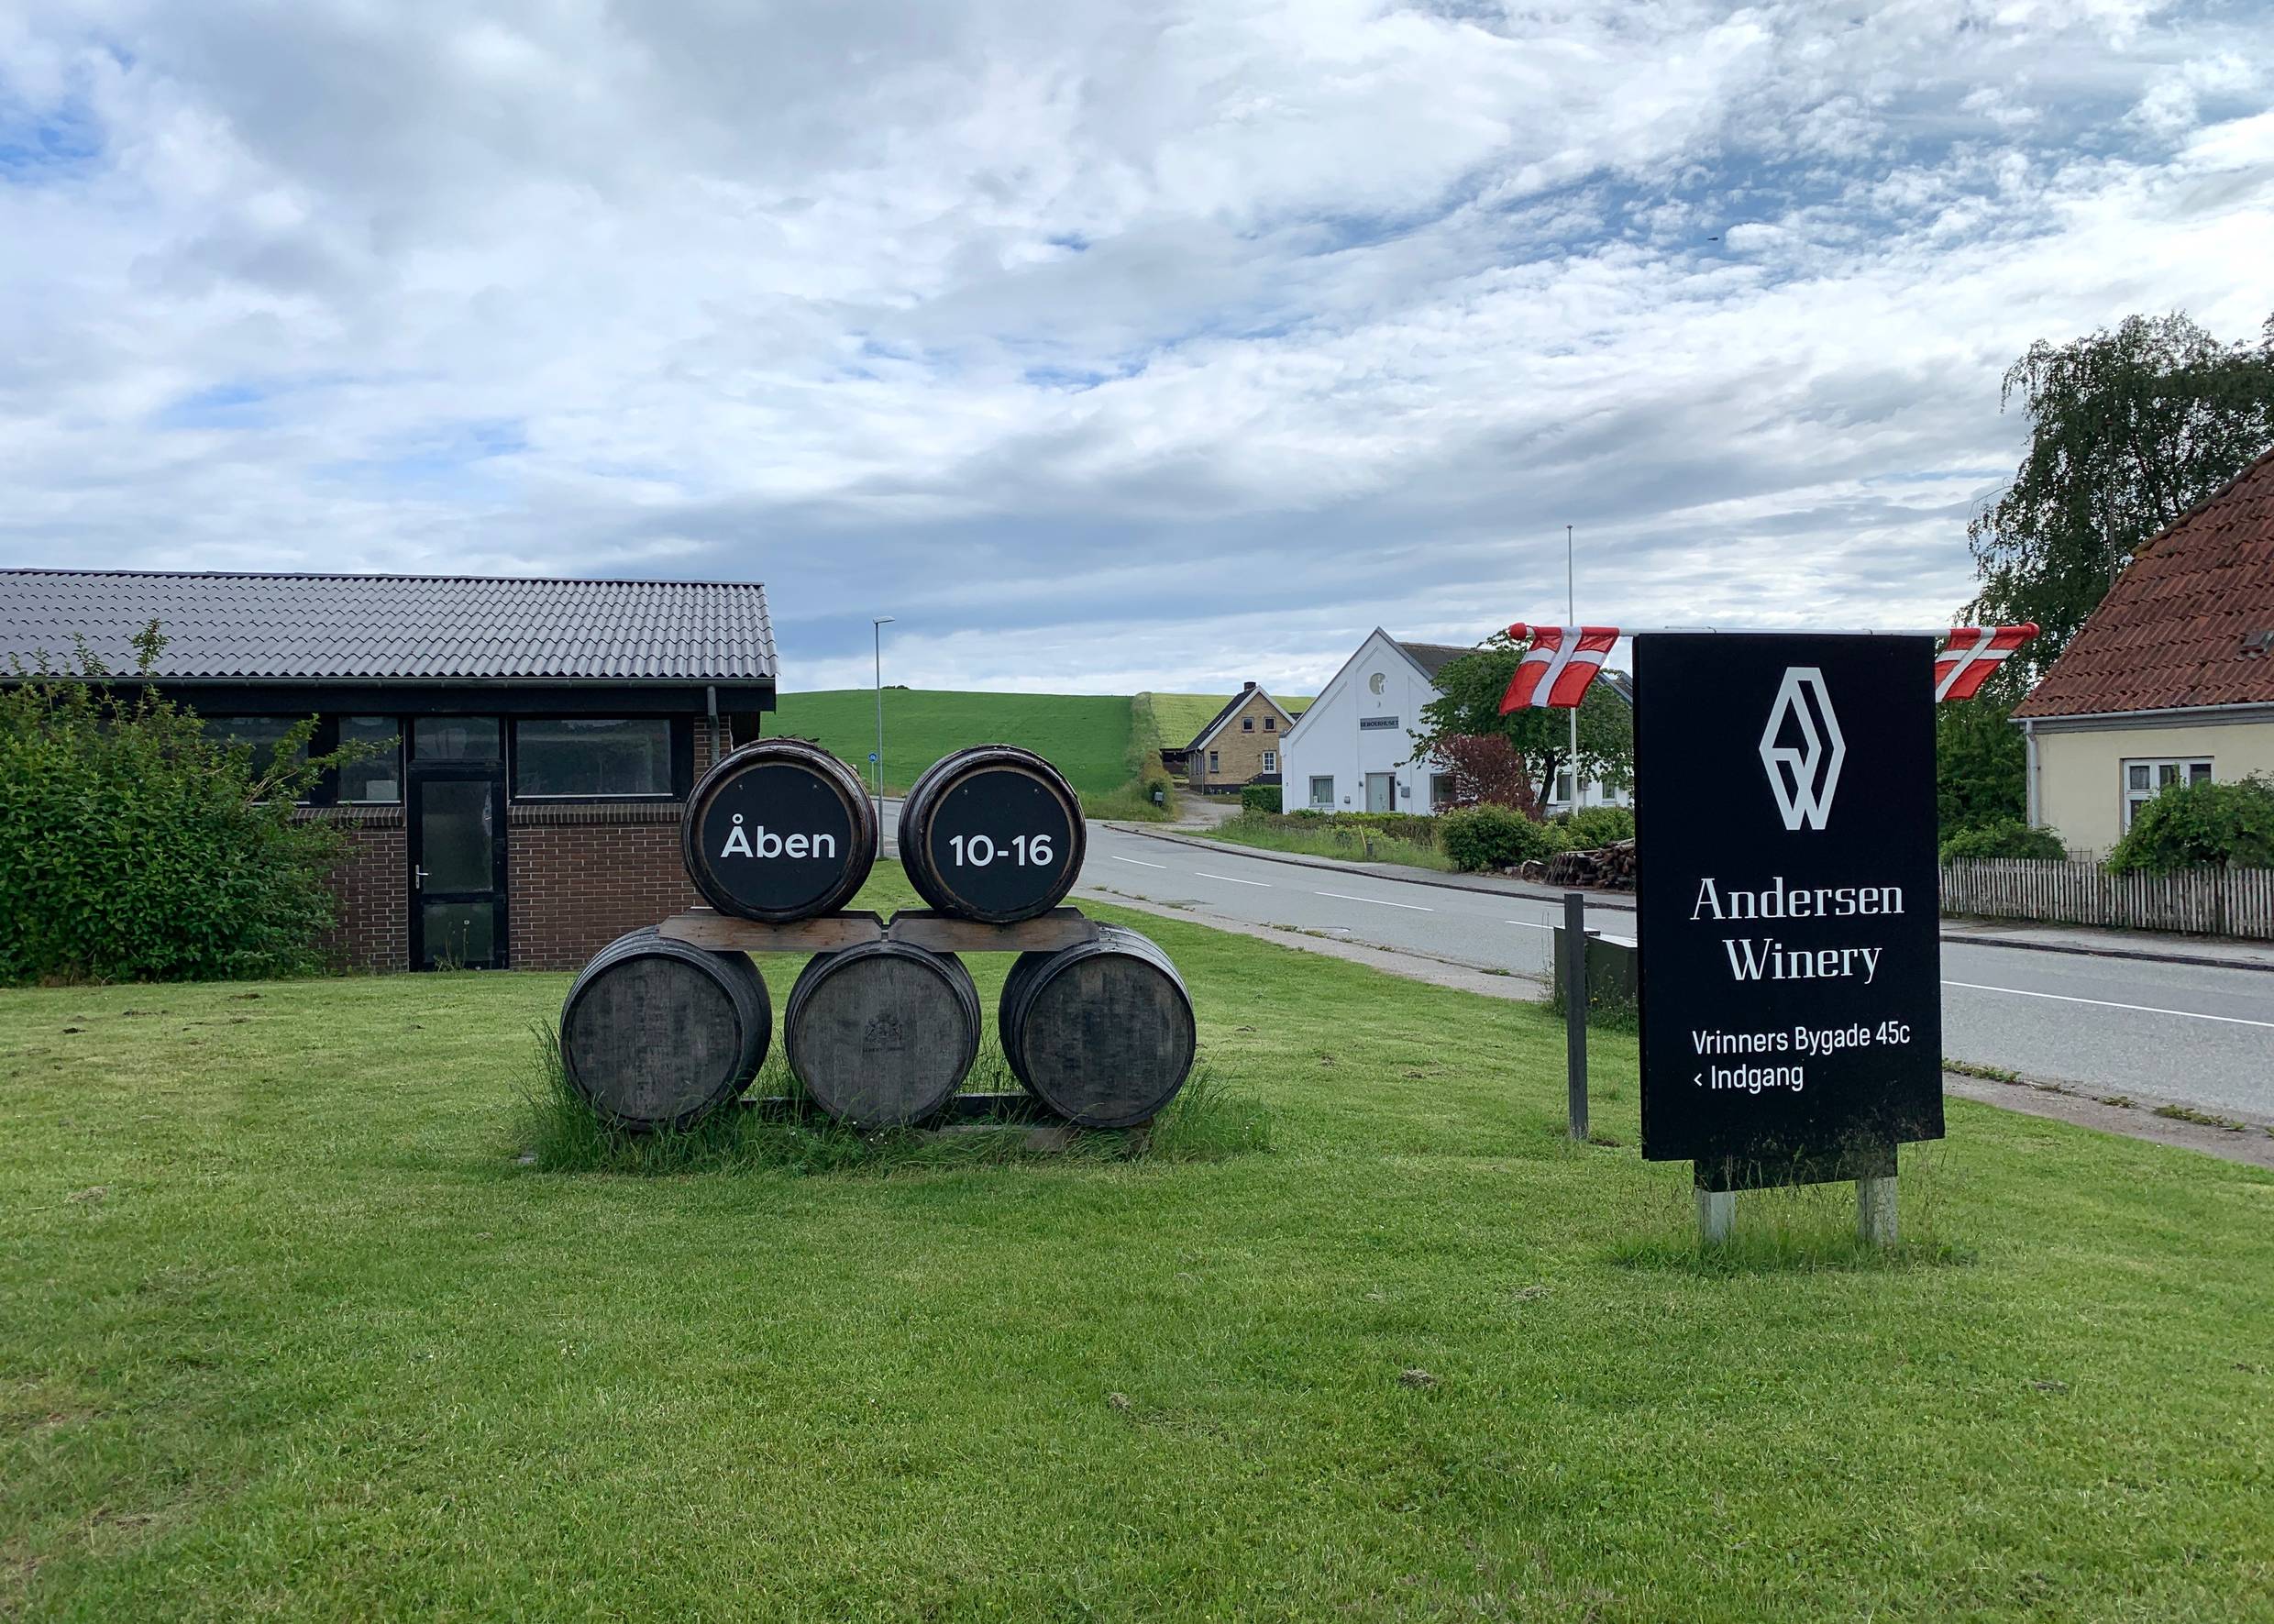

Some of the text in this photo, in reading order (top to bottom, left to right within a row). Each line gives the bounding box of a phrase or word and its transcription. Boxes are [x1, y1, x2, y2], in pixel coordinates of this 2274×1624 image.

[721, 813, 836, 858] Åben
[949, 834, 1054, 867] 10-16
[1689, 876, 1905, 921] Andersen
[1722, 938, 1883, 985] Winery
[1692, 1020, 1911, 1056] Vrinners Bygade 45c
[1711, 1064, 1804, 1095] Indgang
